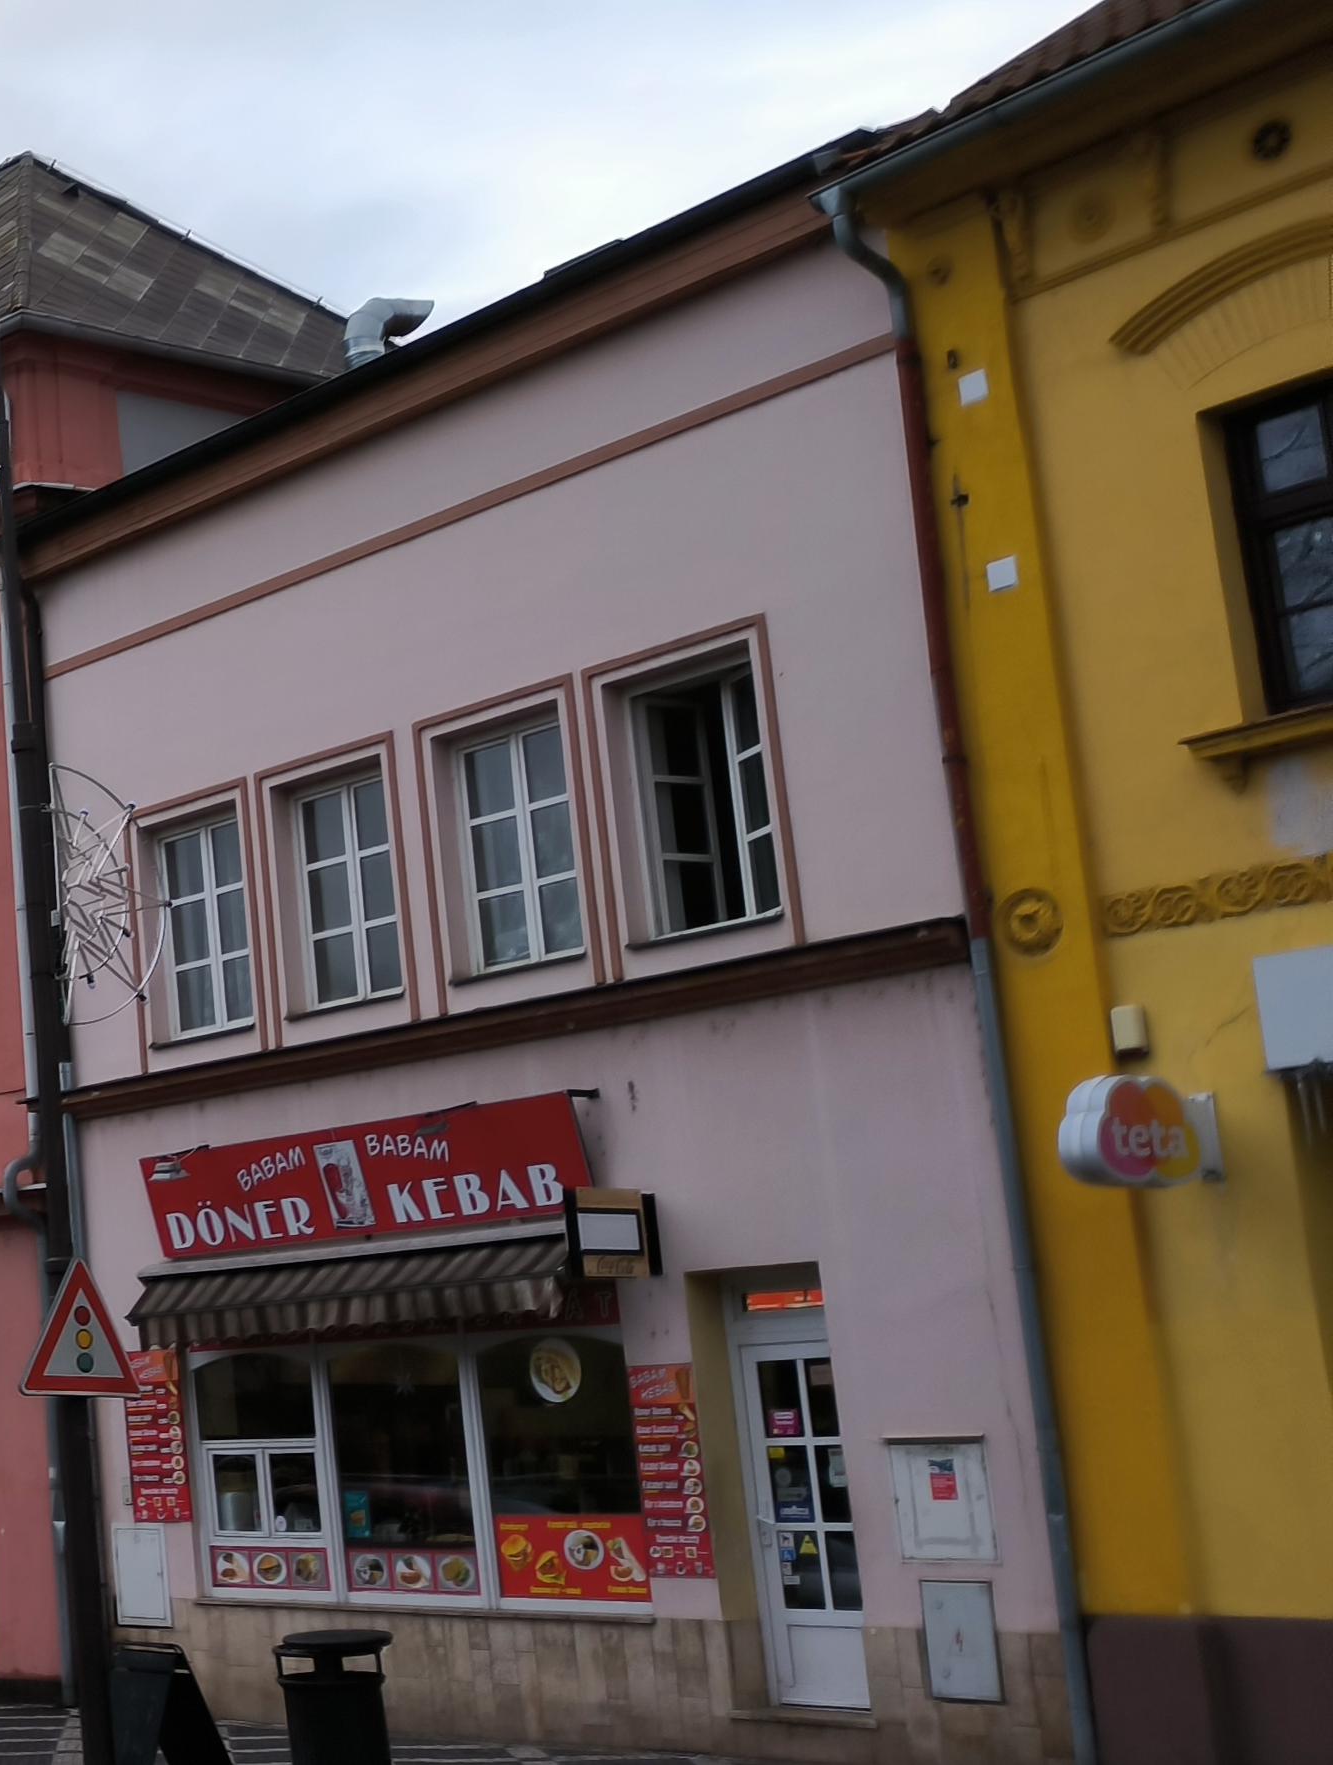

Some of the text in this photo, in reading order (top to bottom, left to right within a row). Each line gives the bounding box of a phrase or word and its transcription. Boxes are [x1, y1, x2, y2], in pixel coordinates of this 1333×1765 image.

[236, 1134, 450, 1191] BABAM BABAM
[1111, 1117, 1190, 1159] teta
[165, 1163, 565, 1251] DÖNER KEBAB
